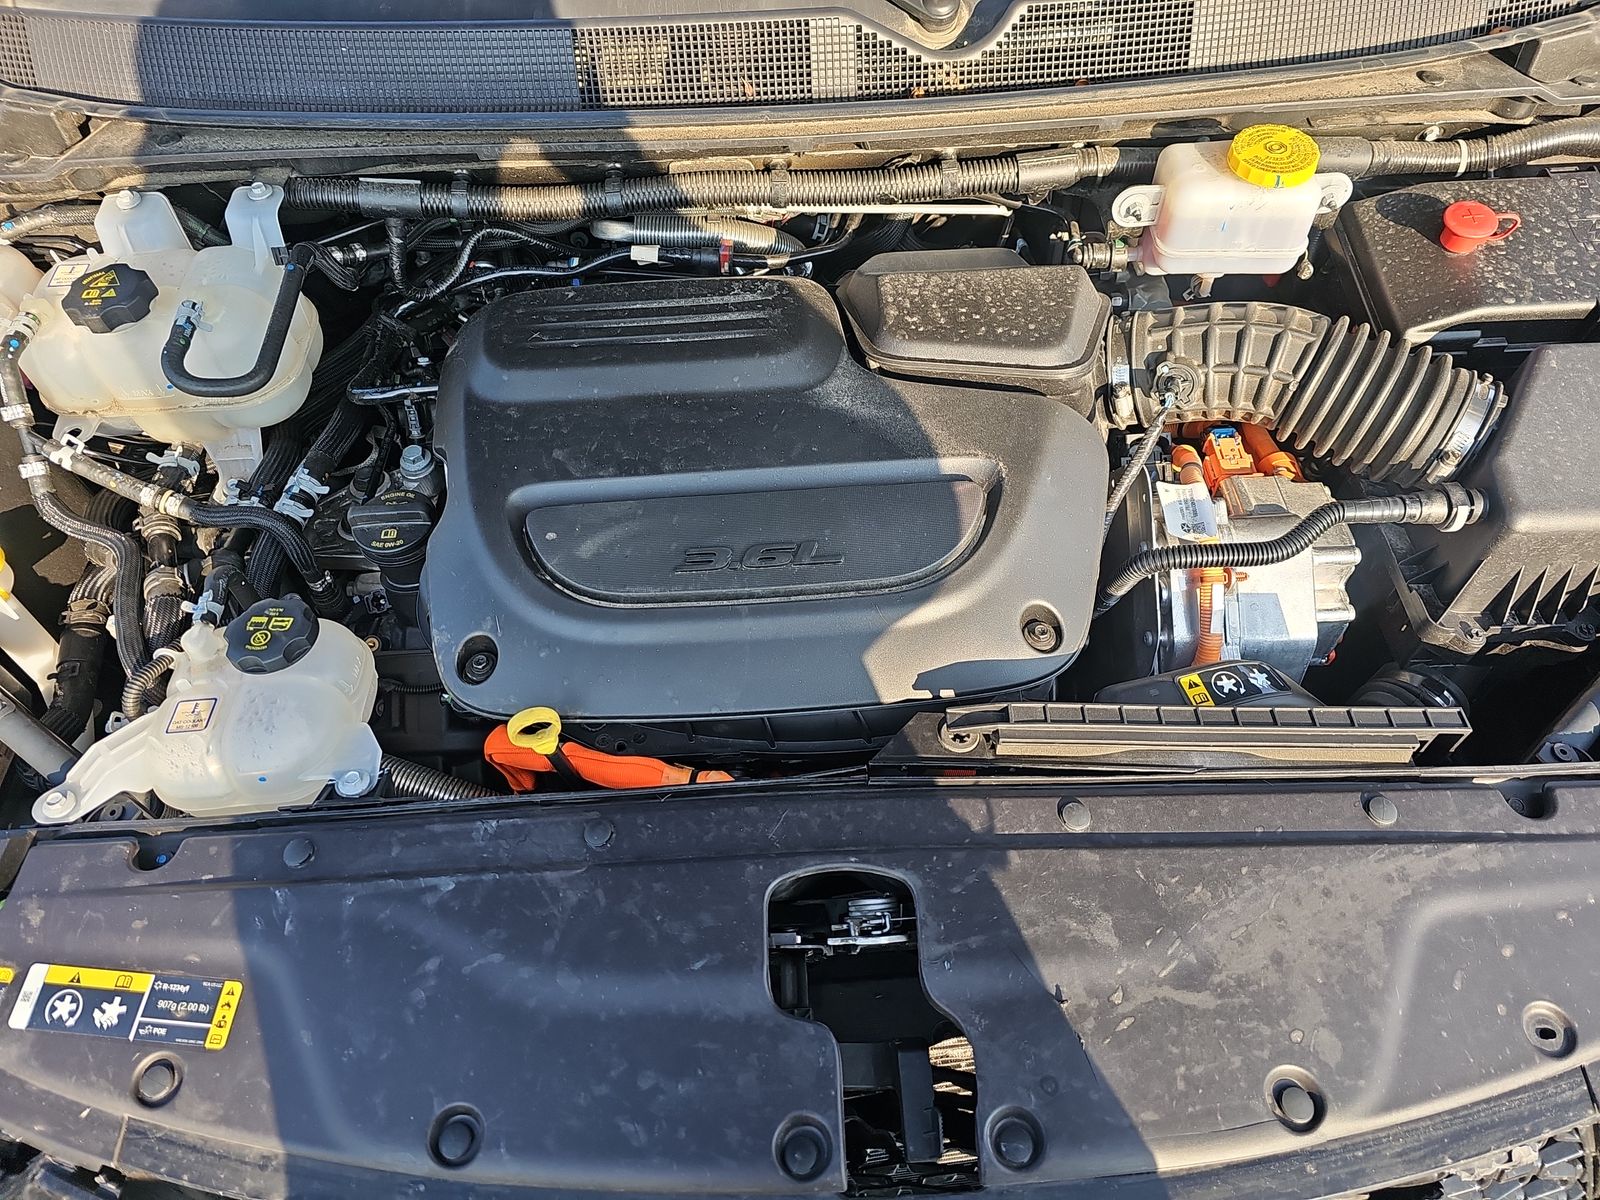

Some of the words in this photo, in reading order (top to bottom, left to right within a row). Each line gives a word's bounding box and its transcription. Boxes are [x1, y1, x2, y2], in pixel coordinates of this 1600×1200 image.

[381, 492, 405, 500] ENGINE
[371, 540, 384, 548] SAE
[385, 539, 403, 548] 0W-20
[675, 540, 844, 574] 3.6L
[157, 1000, 177, 1010] 907g
[178, 1001, 198, 1012] (2.00
[198, 1003, 210, 1013] lb)
